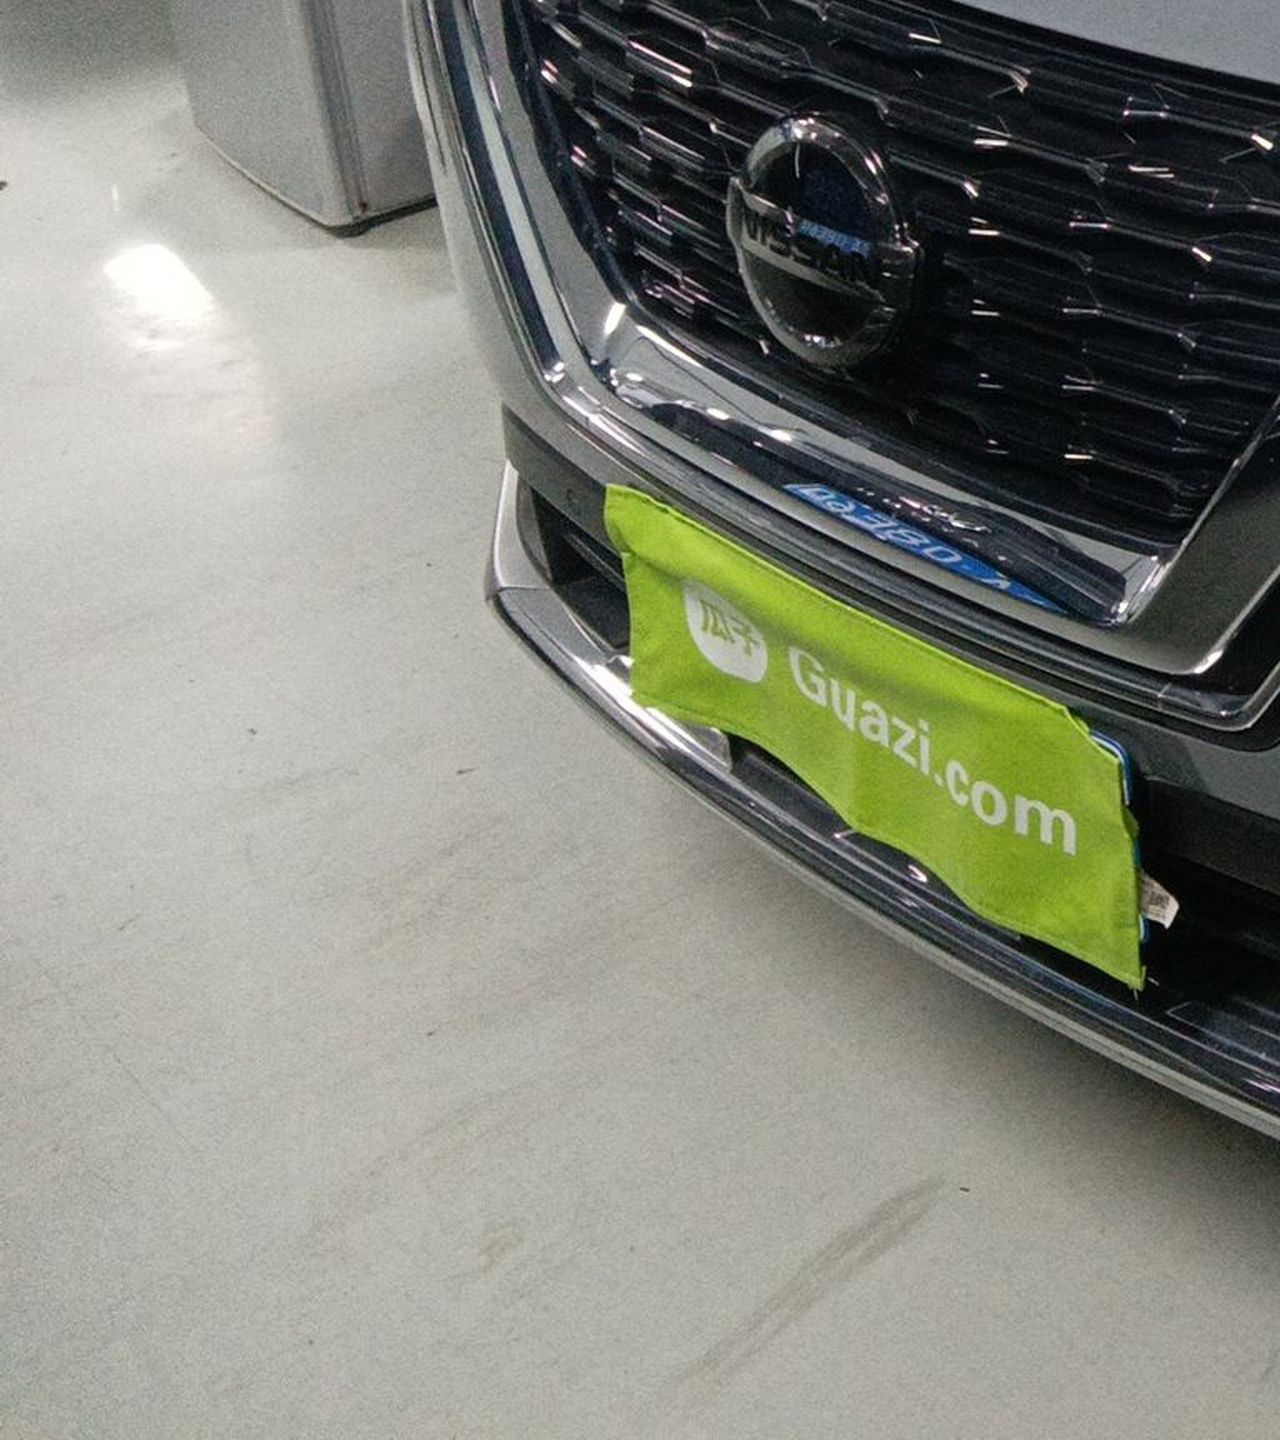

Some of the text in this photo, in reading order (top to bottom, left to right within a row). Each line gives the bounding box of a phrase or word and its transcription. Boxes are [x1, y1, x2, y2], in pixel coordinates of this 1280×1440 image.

[743, 209, 880, 288] NISSAN
[700, 598, 761, 657] 瓜子
[789, 645, 1078, 856] Guazi.com
